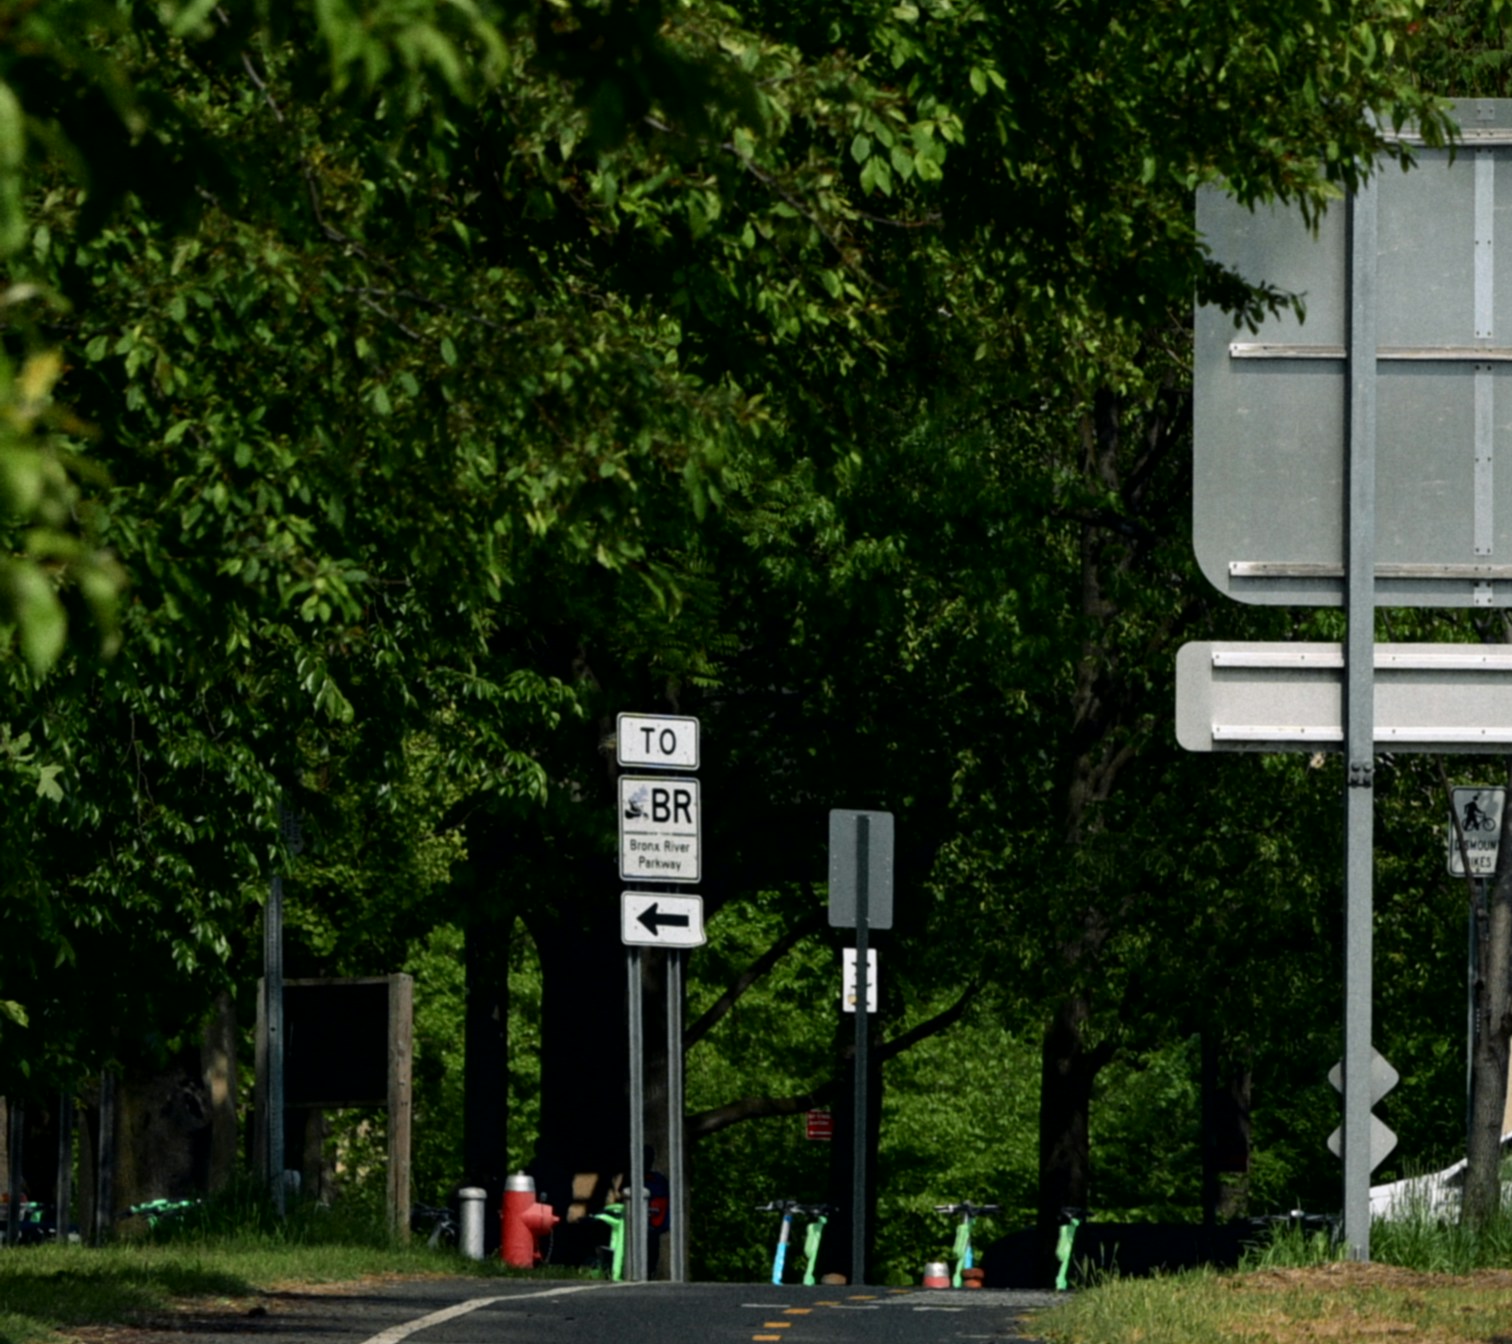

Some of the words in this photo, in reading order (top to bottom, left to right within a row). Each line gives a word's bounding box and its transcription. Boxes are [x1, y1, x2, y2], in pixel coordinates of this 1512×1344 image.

[640, 727, 676, 756] TO
[651, 788, 692, 824] BR
[630, 839, 660, 852] Bronx
[664, 840, 690, 853] River
[638, 857, 681, 872] Parkway
